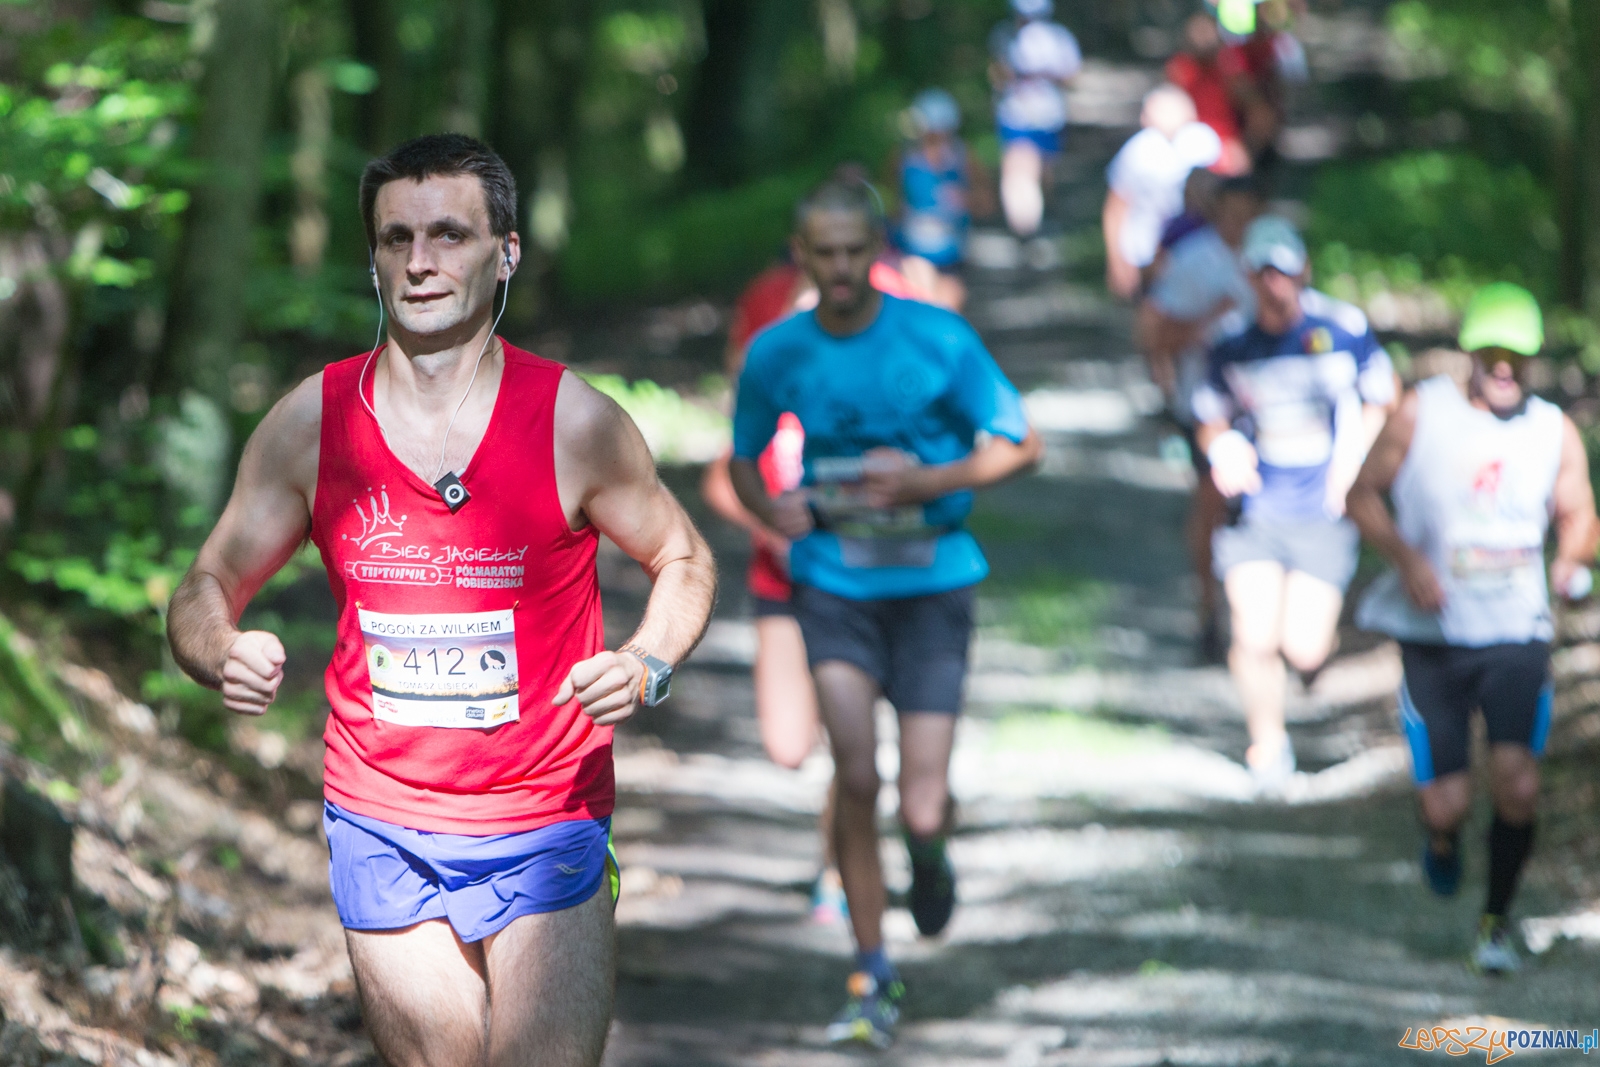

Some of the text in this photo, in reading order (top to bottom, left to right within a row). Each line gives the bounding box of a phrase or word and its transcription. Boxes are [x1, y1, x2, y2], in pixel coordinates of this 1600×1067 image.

[370, 542, 430, 559] BIEG
[361, 566, 427, 581] TIPTOPOL
[455, 564, 525, 577] PÓŁMARATON
[456, 577, 524, 589] POBIEDZISKA
[371, 620, 501, 635] POGOŃ ZA WILKIEM
[403, 647, 466, 676] 412
[398, 681, 435, 690] TOMASZ
